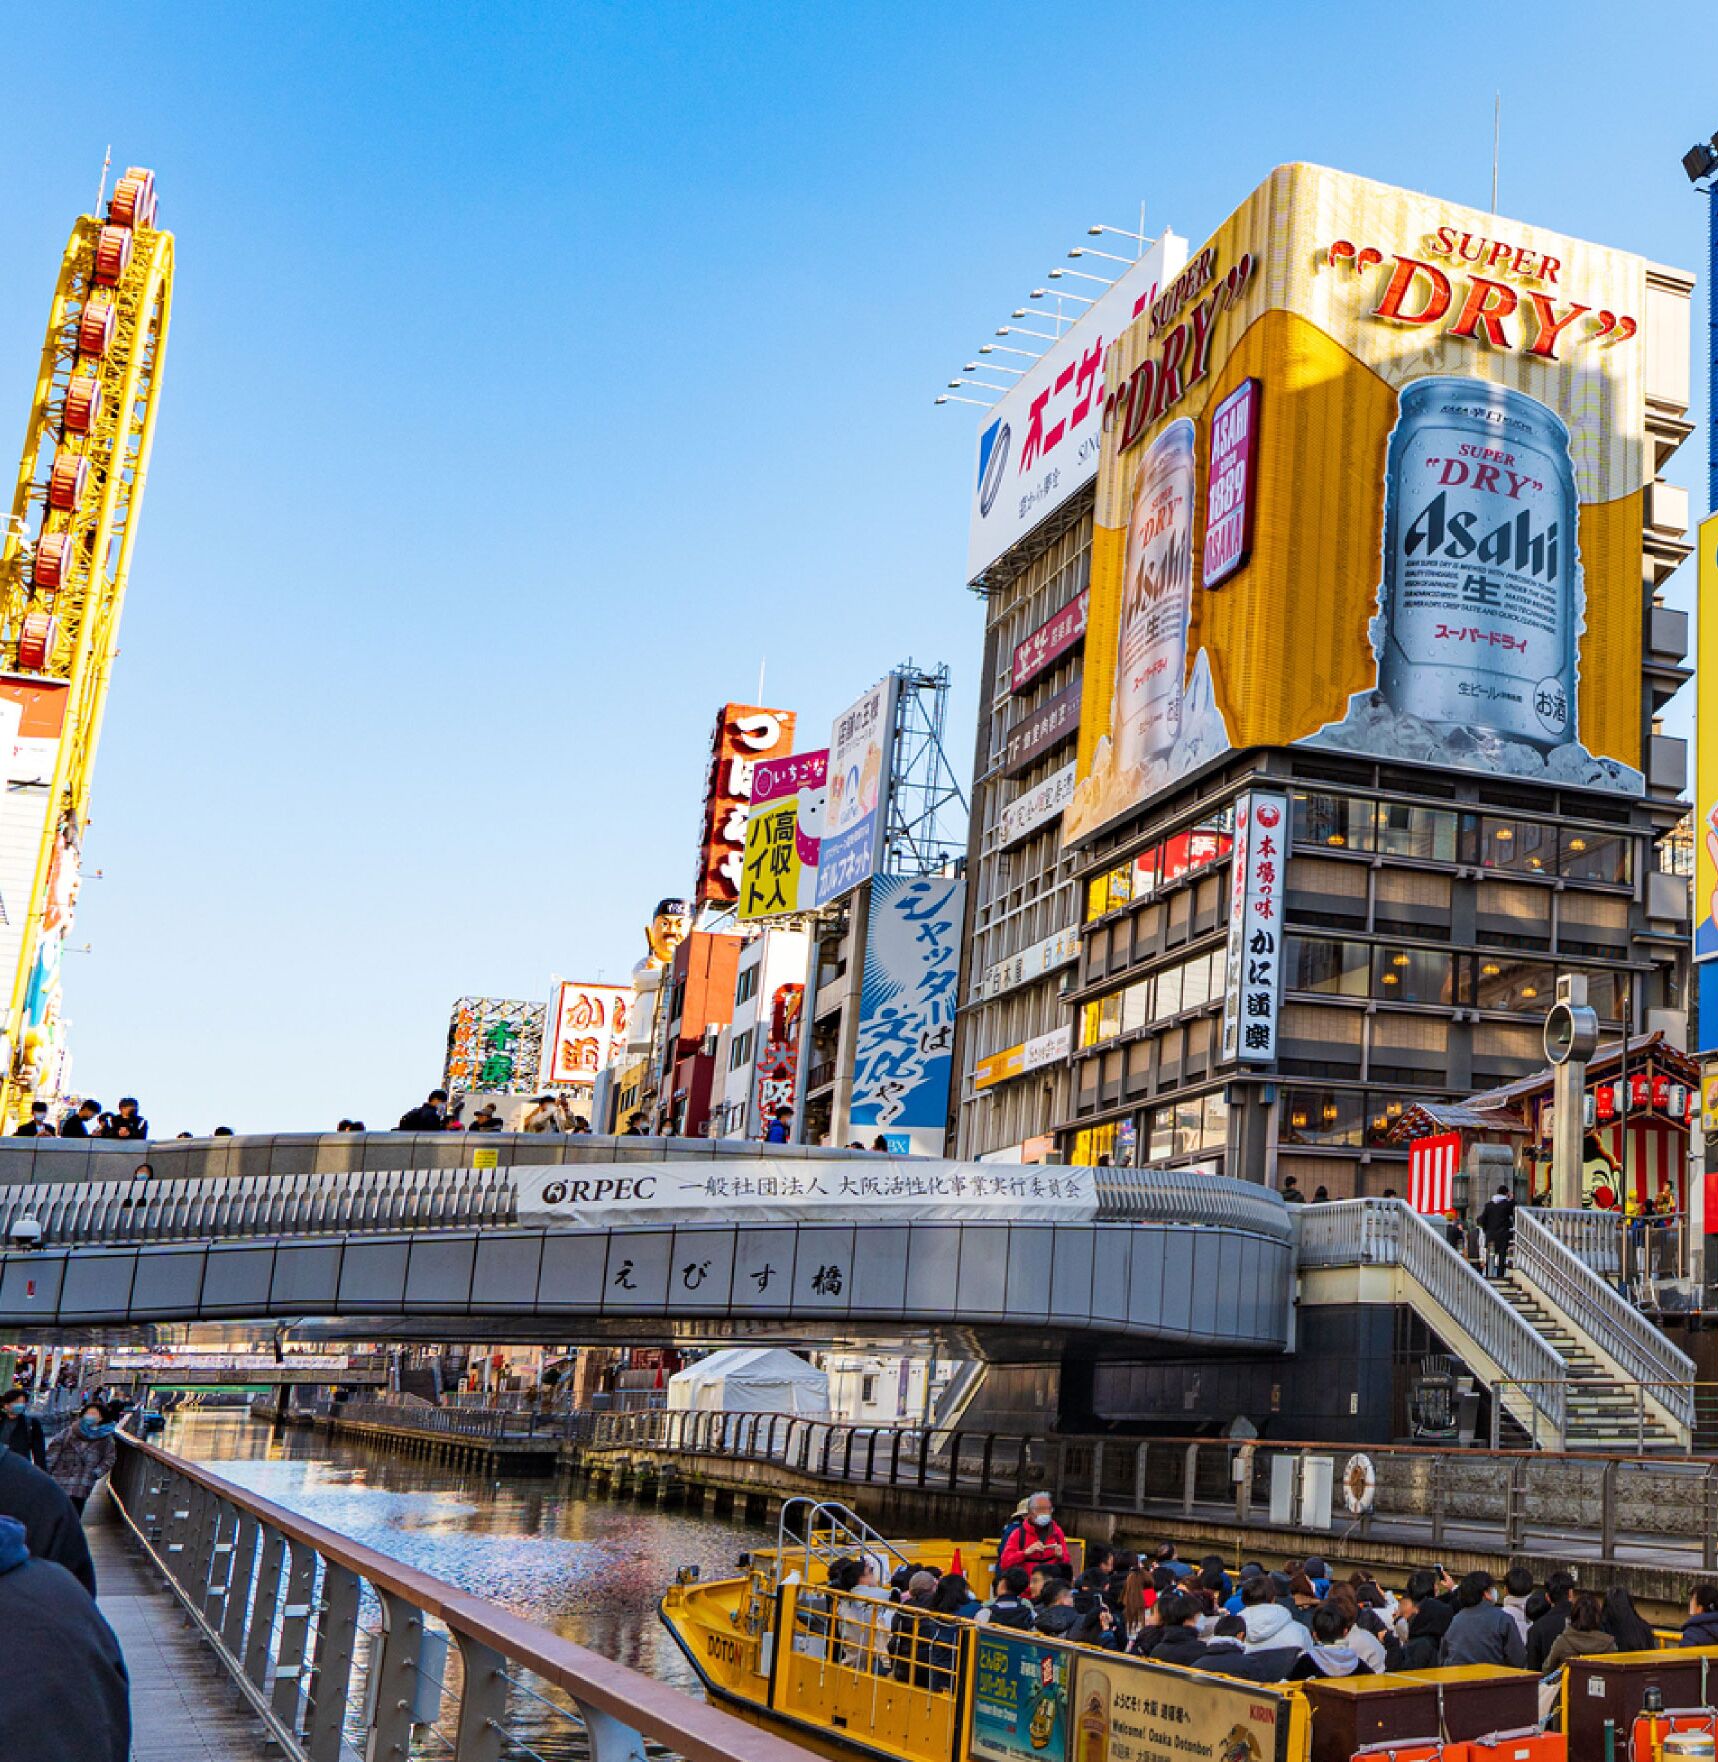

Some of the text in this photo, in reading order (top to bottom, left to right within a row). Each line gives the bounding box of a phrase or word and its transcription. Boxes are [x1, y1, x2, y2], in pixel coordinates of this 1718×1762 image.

[1431, 226, 1561, 284] SUPER
[1149, 248, 1214, 341] SUPER
[1212, 396, 1249, 464] ASAHI
[1458, 444, 1516, 467] SUPER
[1209, 460, 1245, 524] 1889
[1205, 513, 1242, 576] OSAKA
[1404, 490, 1558, 582] Asahi
[1463, 574, 1501, 606] 生
[1434, 624, 1527, 653] スーパードライ
[1536, 688, 1566, 723] お酒
[748, 814, 774, 913] バイト
[765, 810, 797, 910] 高収入
[1255, 834, 1277, 920] 本場の味
[1245, 927, 1274, 1050] かに道楽
[542, 1175, 1080, 1203] ORPEC 一般社団法人 大阪活性化事業実行委員会
[615, 1260, 843, 1296] えびす橋
[1149, 1728, 1171, 1747] Osaka
[1174, 1734, 1213, 1757] Dotonbori
[1250, 1703, 1275, 1724] KIRIN
